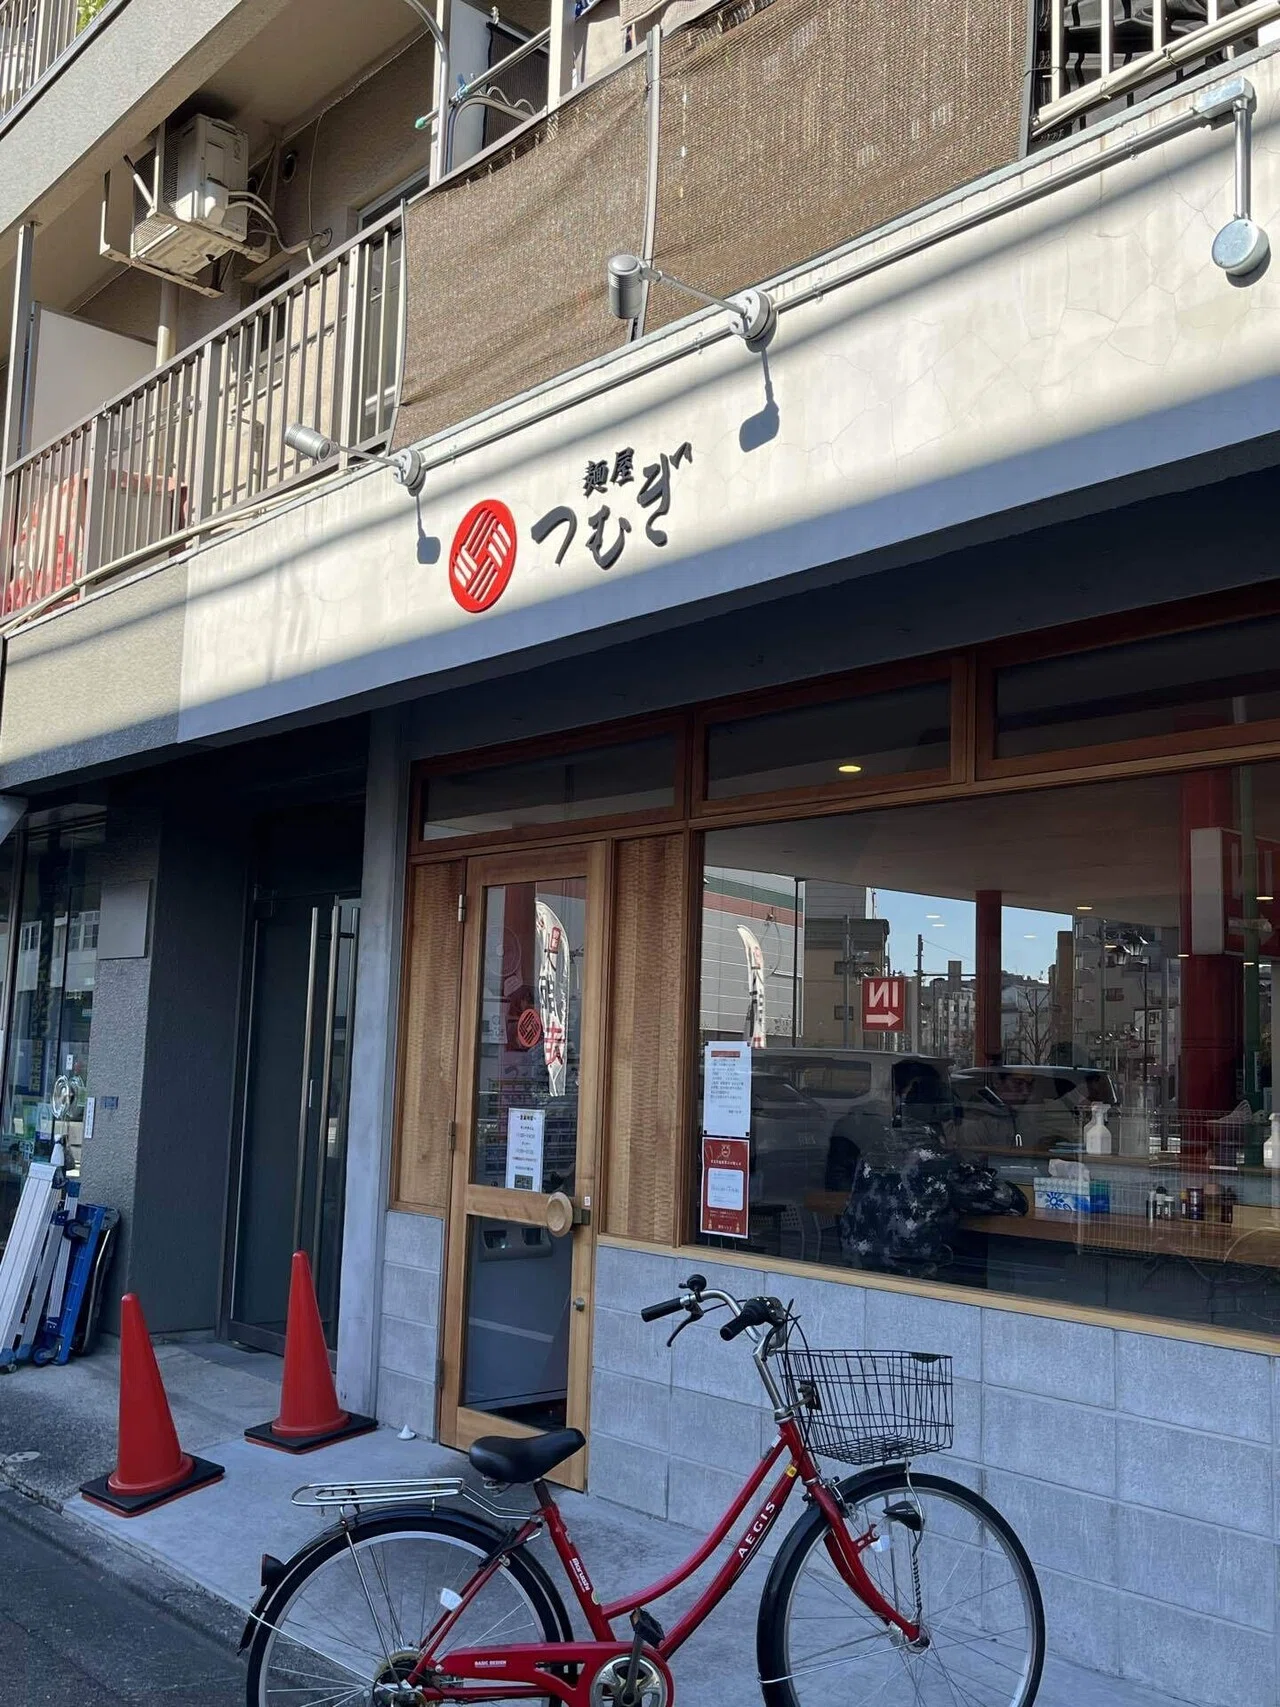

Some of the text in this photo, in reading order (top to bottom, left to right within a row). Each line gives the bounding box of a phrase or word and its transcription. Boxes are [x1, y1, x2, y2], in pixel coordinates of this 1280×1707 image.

[583, 447, 635, 498] 麺屋
[531, 441, 693, 570] つむぎ
[738, 1501, 776, 1559] AEGIS
